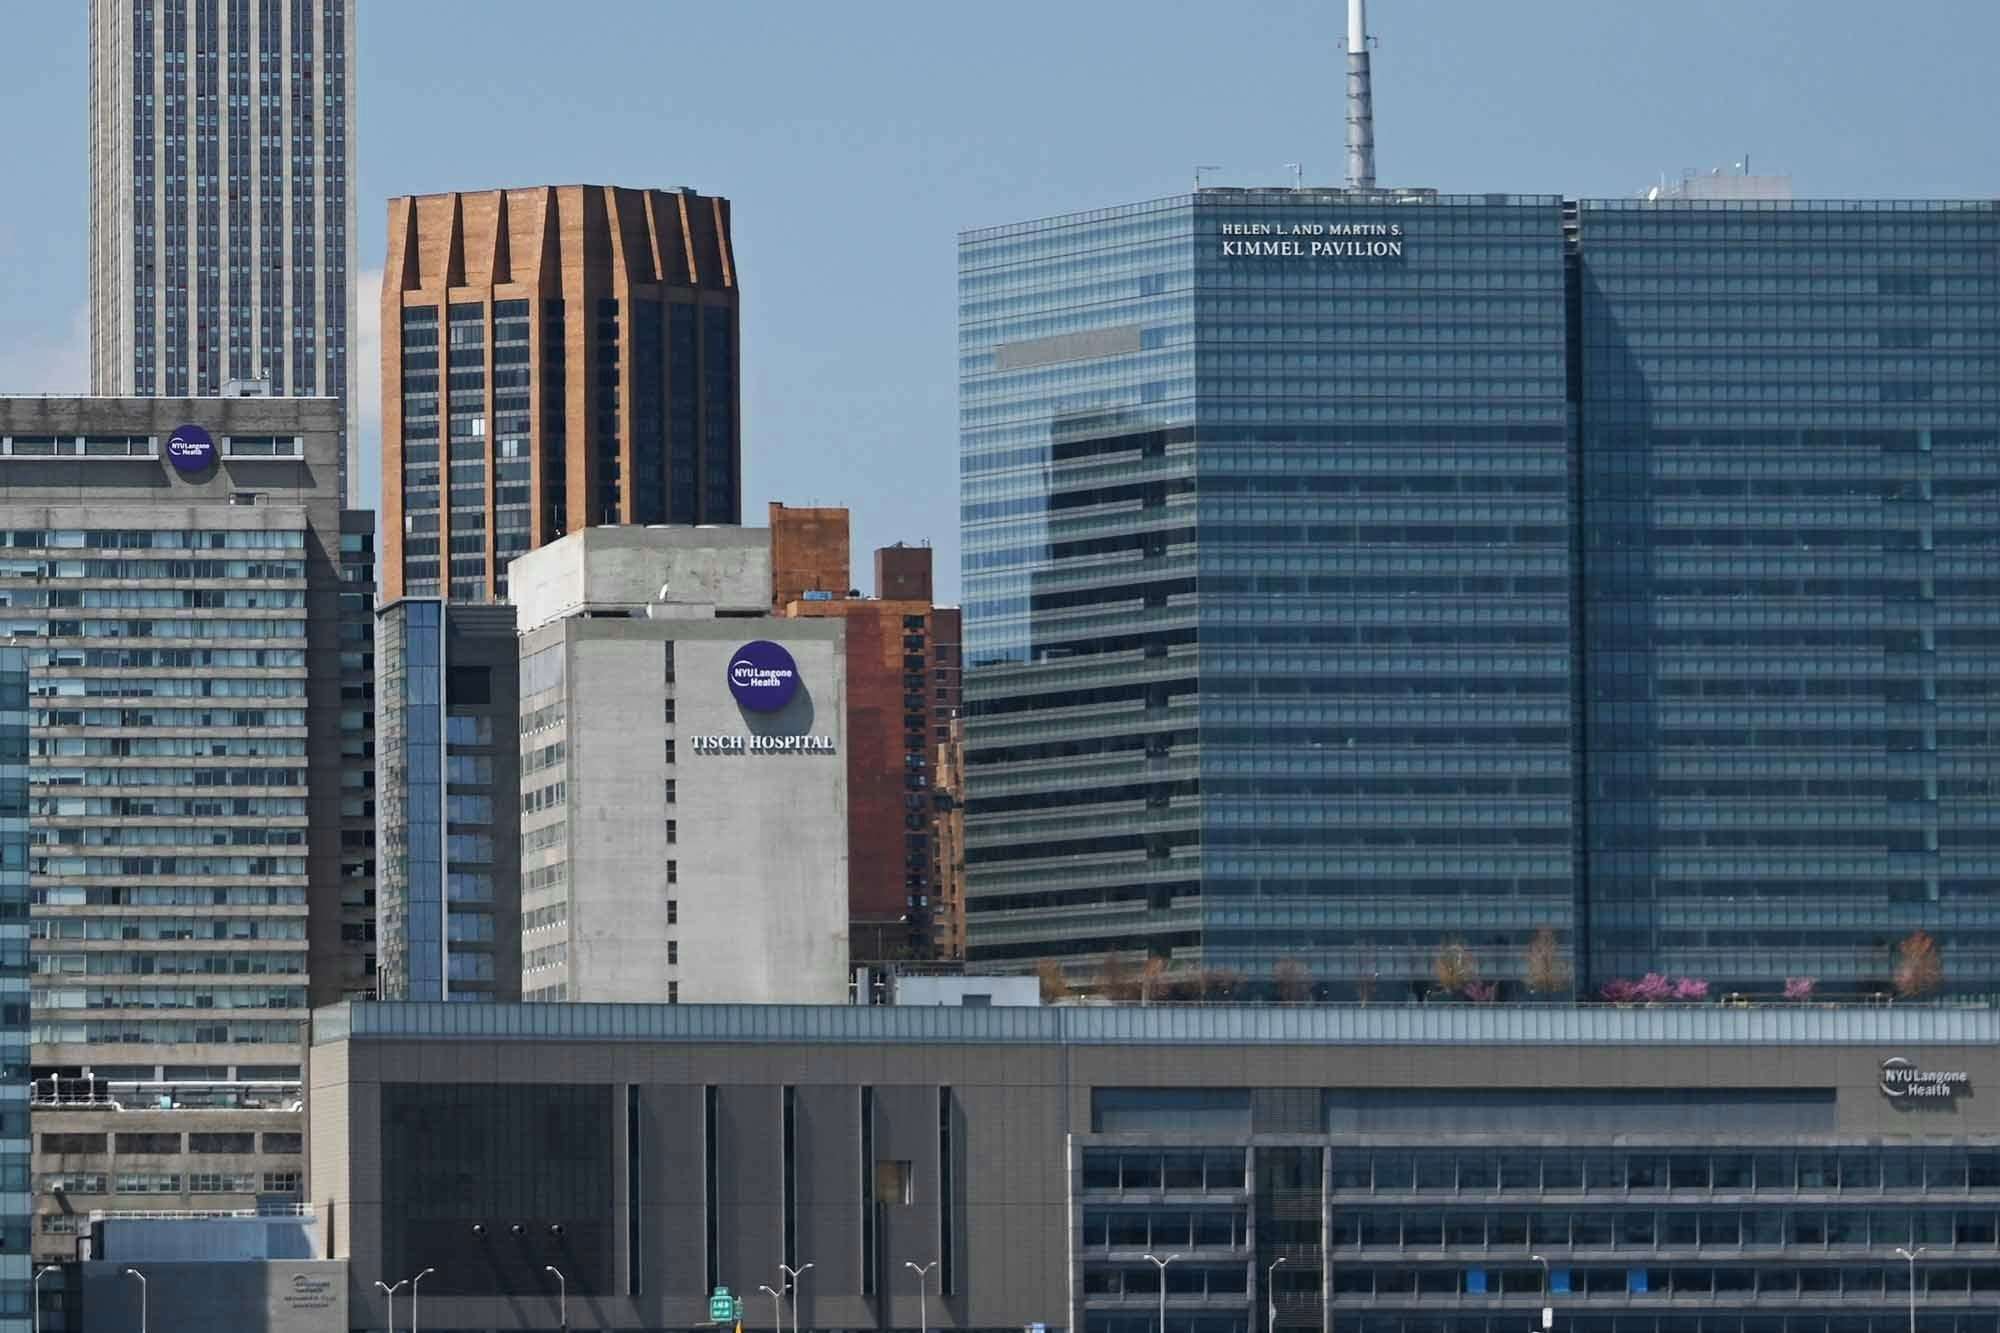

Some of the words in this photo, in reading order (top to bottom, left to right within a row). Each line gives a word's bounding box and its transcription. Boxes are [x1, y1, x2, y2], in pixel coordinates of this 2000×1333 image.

[1222, 224, 1271, 235] HELEN
[1277, 224, 1288, 235] L.
[1292, 224, 1323, 235] AND
[1329, 224, 1387, 235] MARTIN
[1391, 224, 1402, 236] S.
[1222, 241, 1305, 256] KIMMEL
[1311, 241, 1402, 256] PAVILION
[734, 668, 754, 678] NYU
[754, 668, 792, 680] Langone
[750, 678, 781, 687] Health
[690, 735, 742, 749] TISCH
[749, 735, 833, 749] HOSPITAL
[1885, 1069, 1913, 1082] NYU
[1913, 1069, 1968, 1084] Langone
[1907, 1083, 1951, 1096] Health
